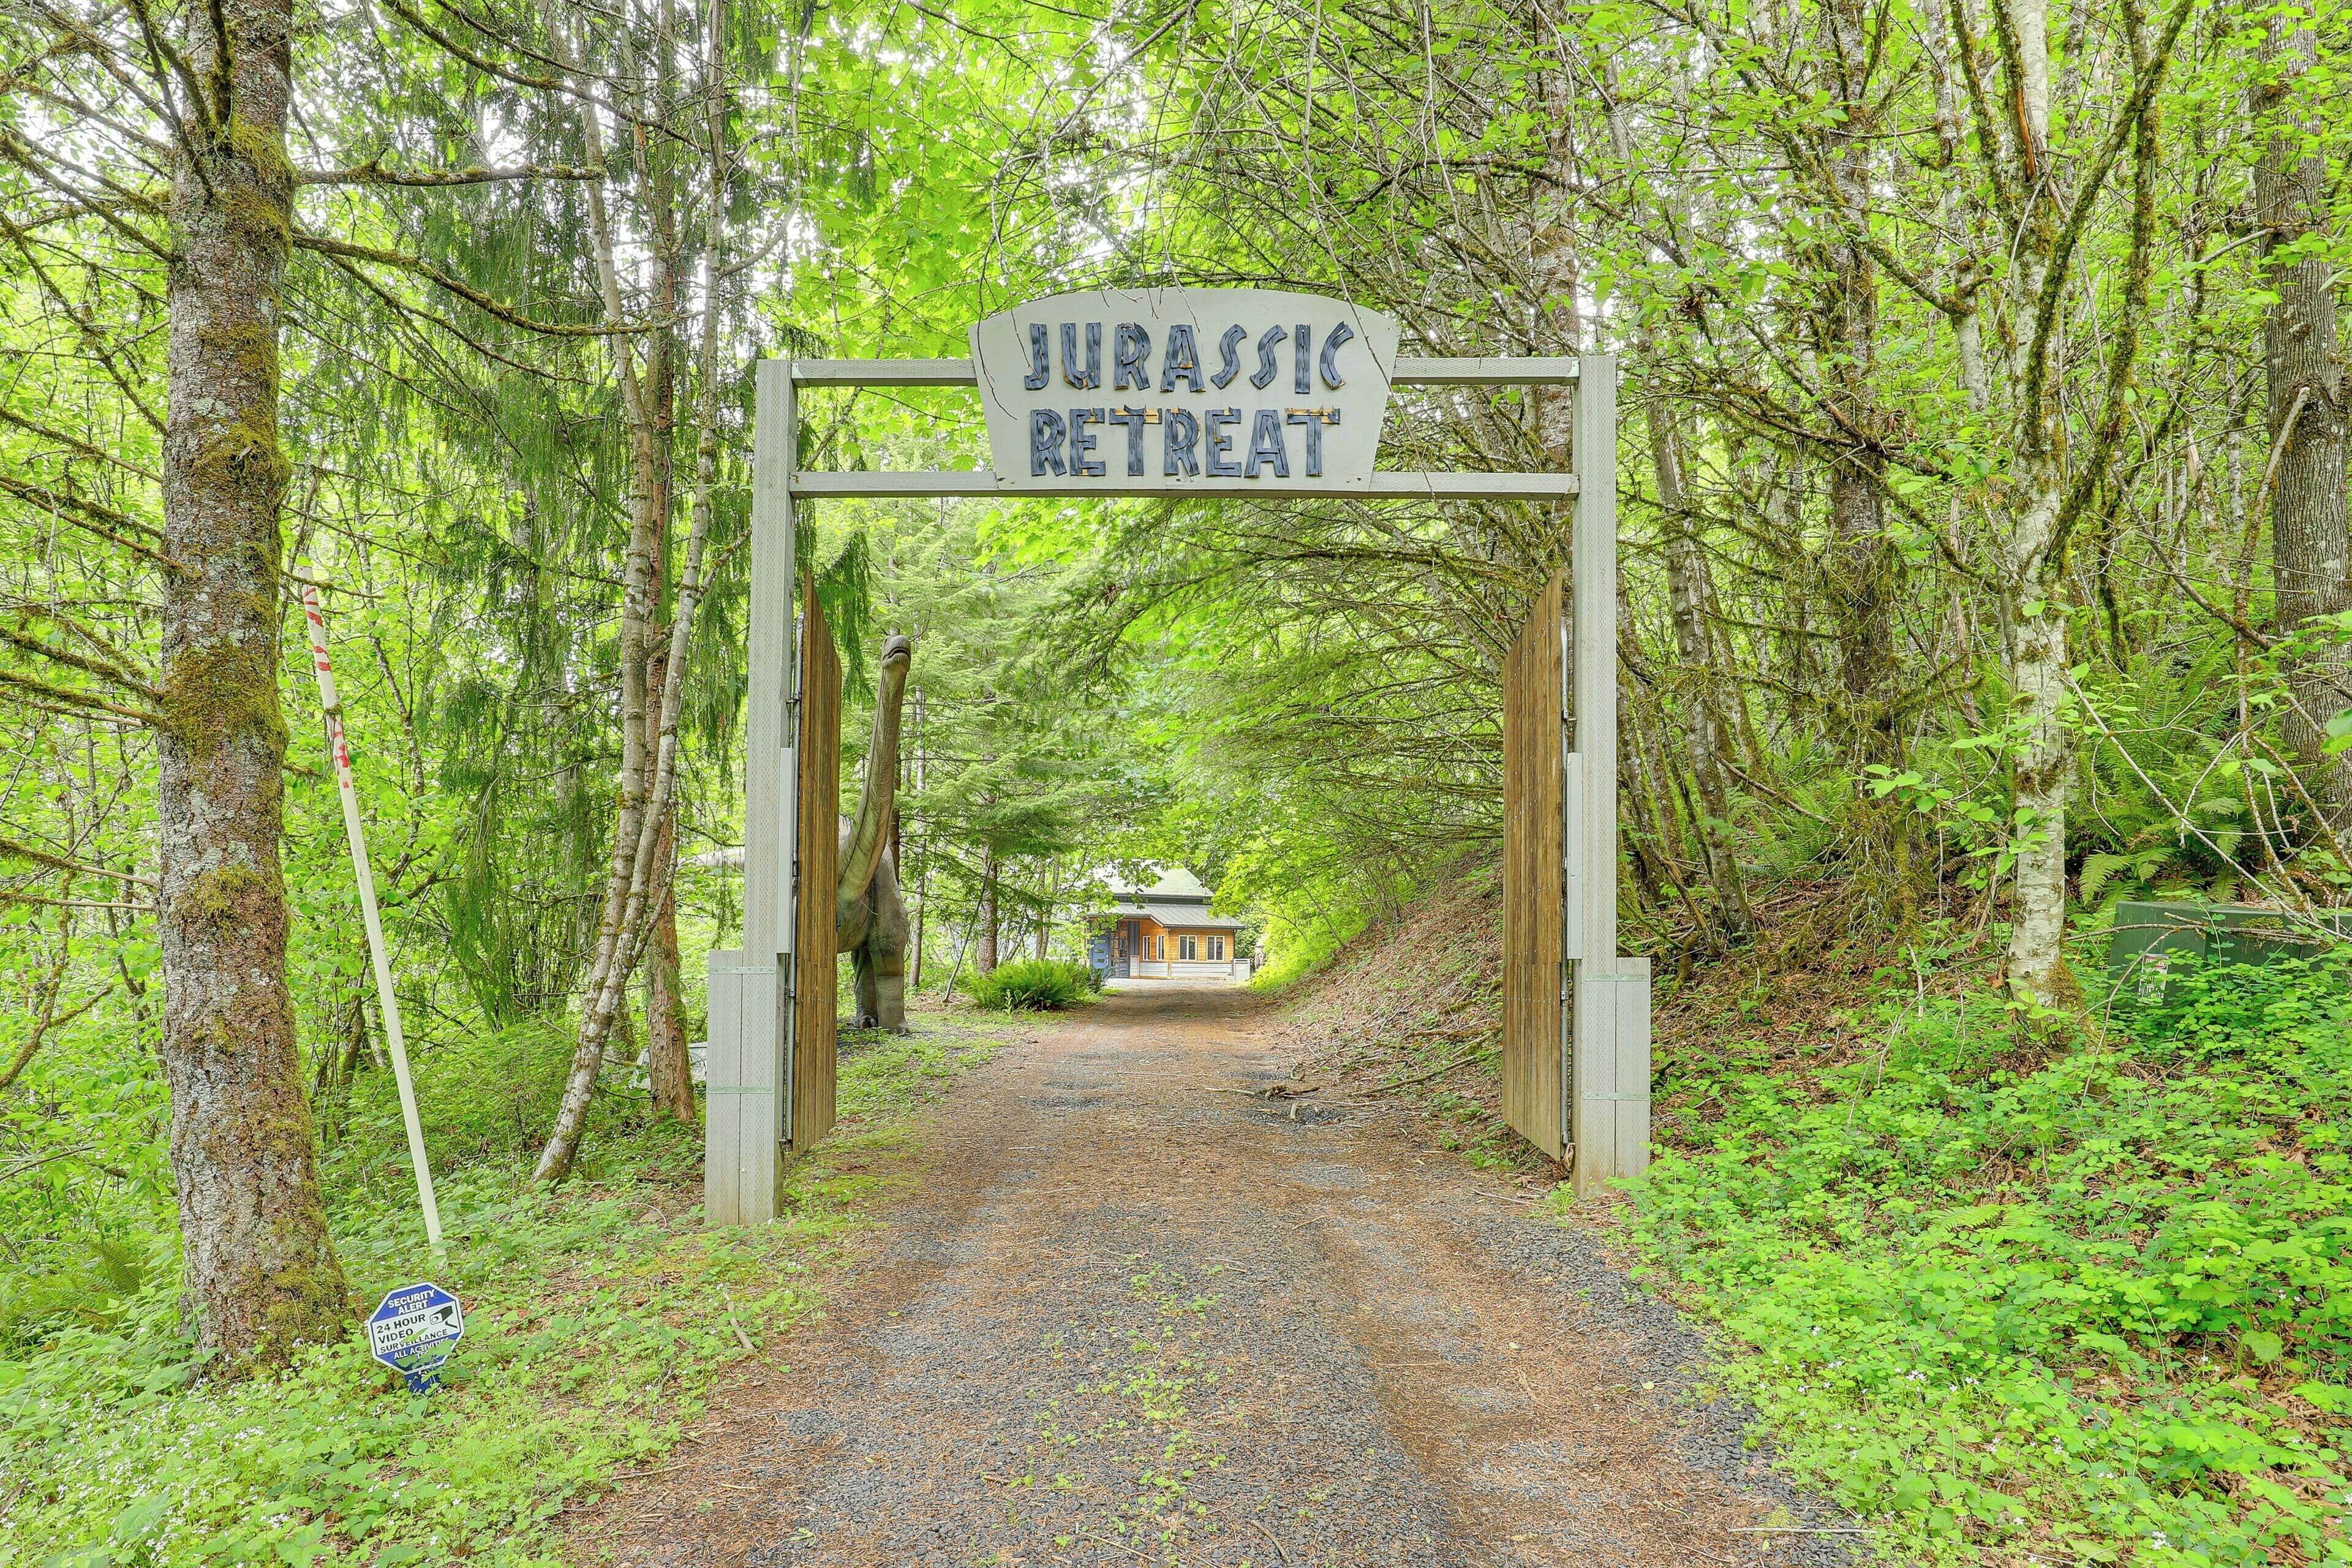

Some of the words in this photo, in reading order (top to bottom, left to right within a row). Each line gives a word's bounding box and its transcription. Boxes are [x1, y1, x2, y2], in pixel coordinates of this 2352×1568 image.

[1025, 322, 1354, 394] JURASSIC
[1030, 404, 1340, 478] RETREAT
[388, 1289, 435, 1308] SECURITY
[398, 1300, 428, 1315] ALERT
[377, 1323, 391, 1334] 24
[393, 1314, 426, 1329] HOUR
[378, 1328, 413, 1344] VIDEO
[380, 1329, 448, 1353] SURVEILLANCE
[394, 1349, 408, 1360] ALL
